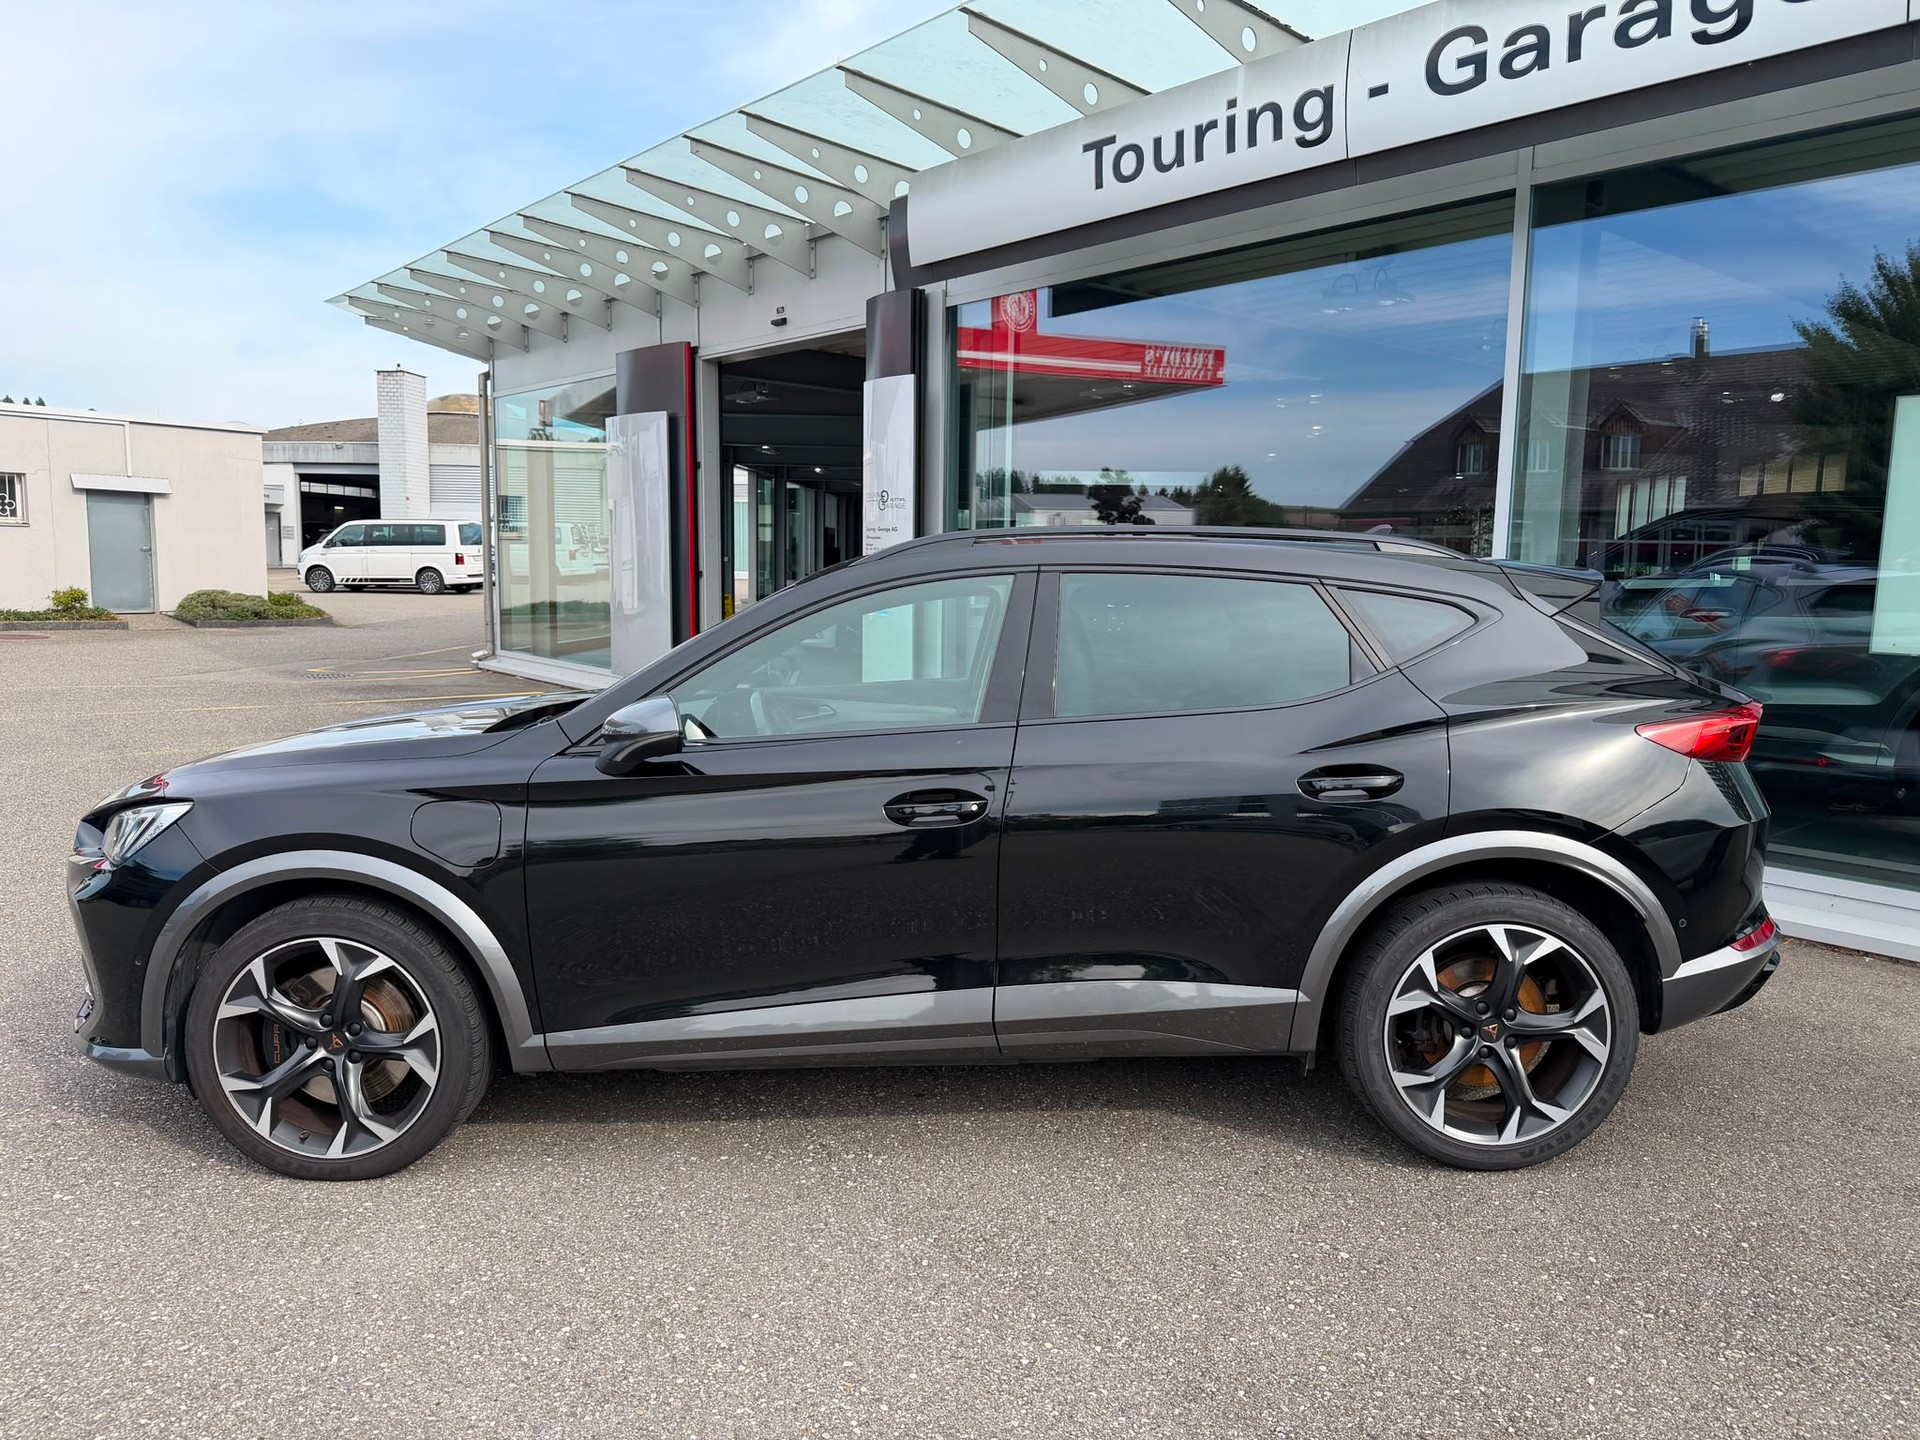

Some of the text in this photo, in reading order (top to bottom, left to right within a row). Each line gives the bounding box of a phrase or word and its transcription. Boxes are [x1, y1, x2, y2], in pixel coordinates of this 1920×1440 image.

[1082, 0, 1815, 191] Touring - Garag
